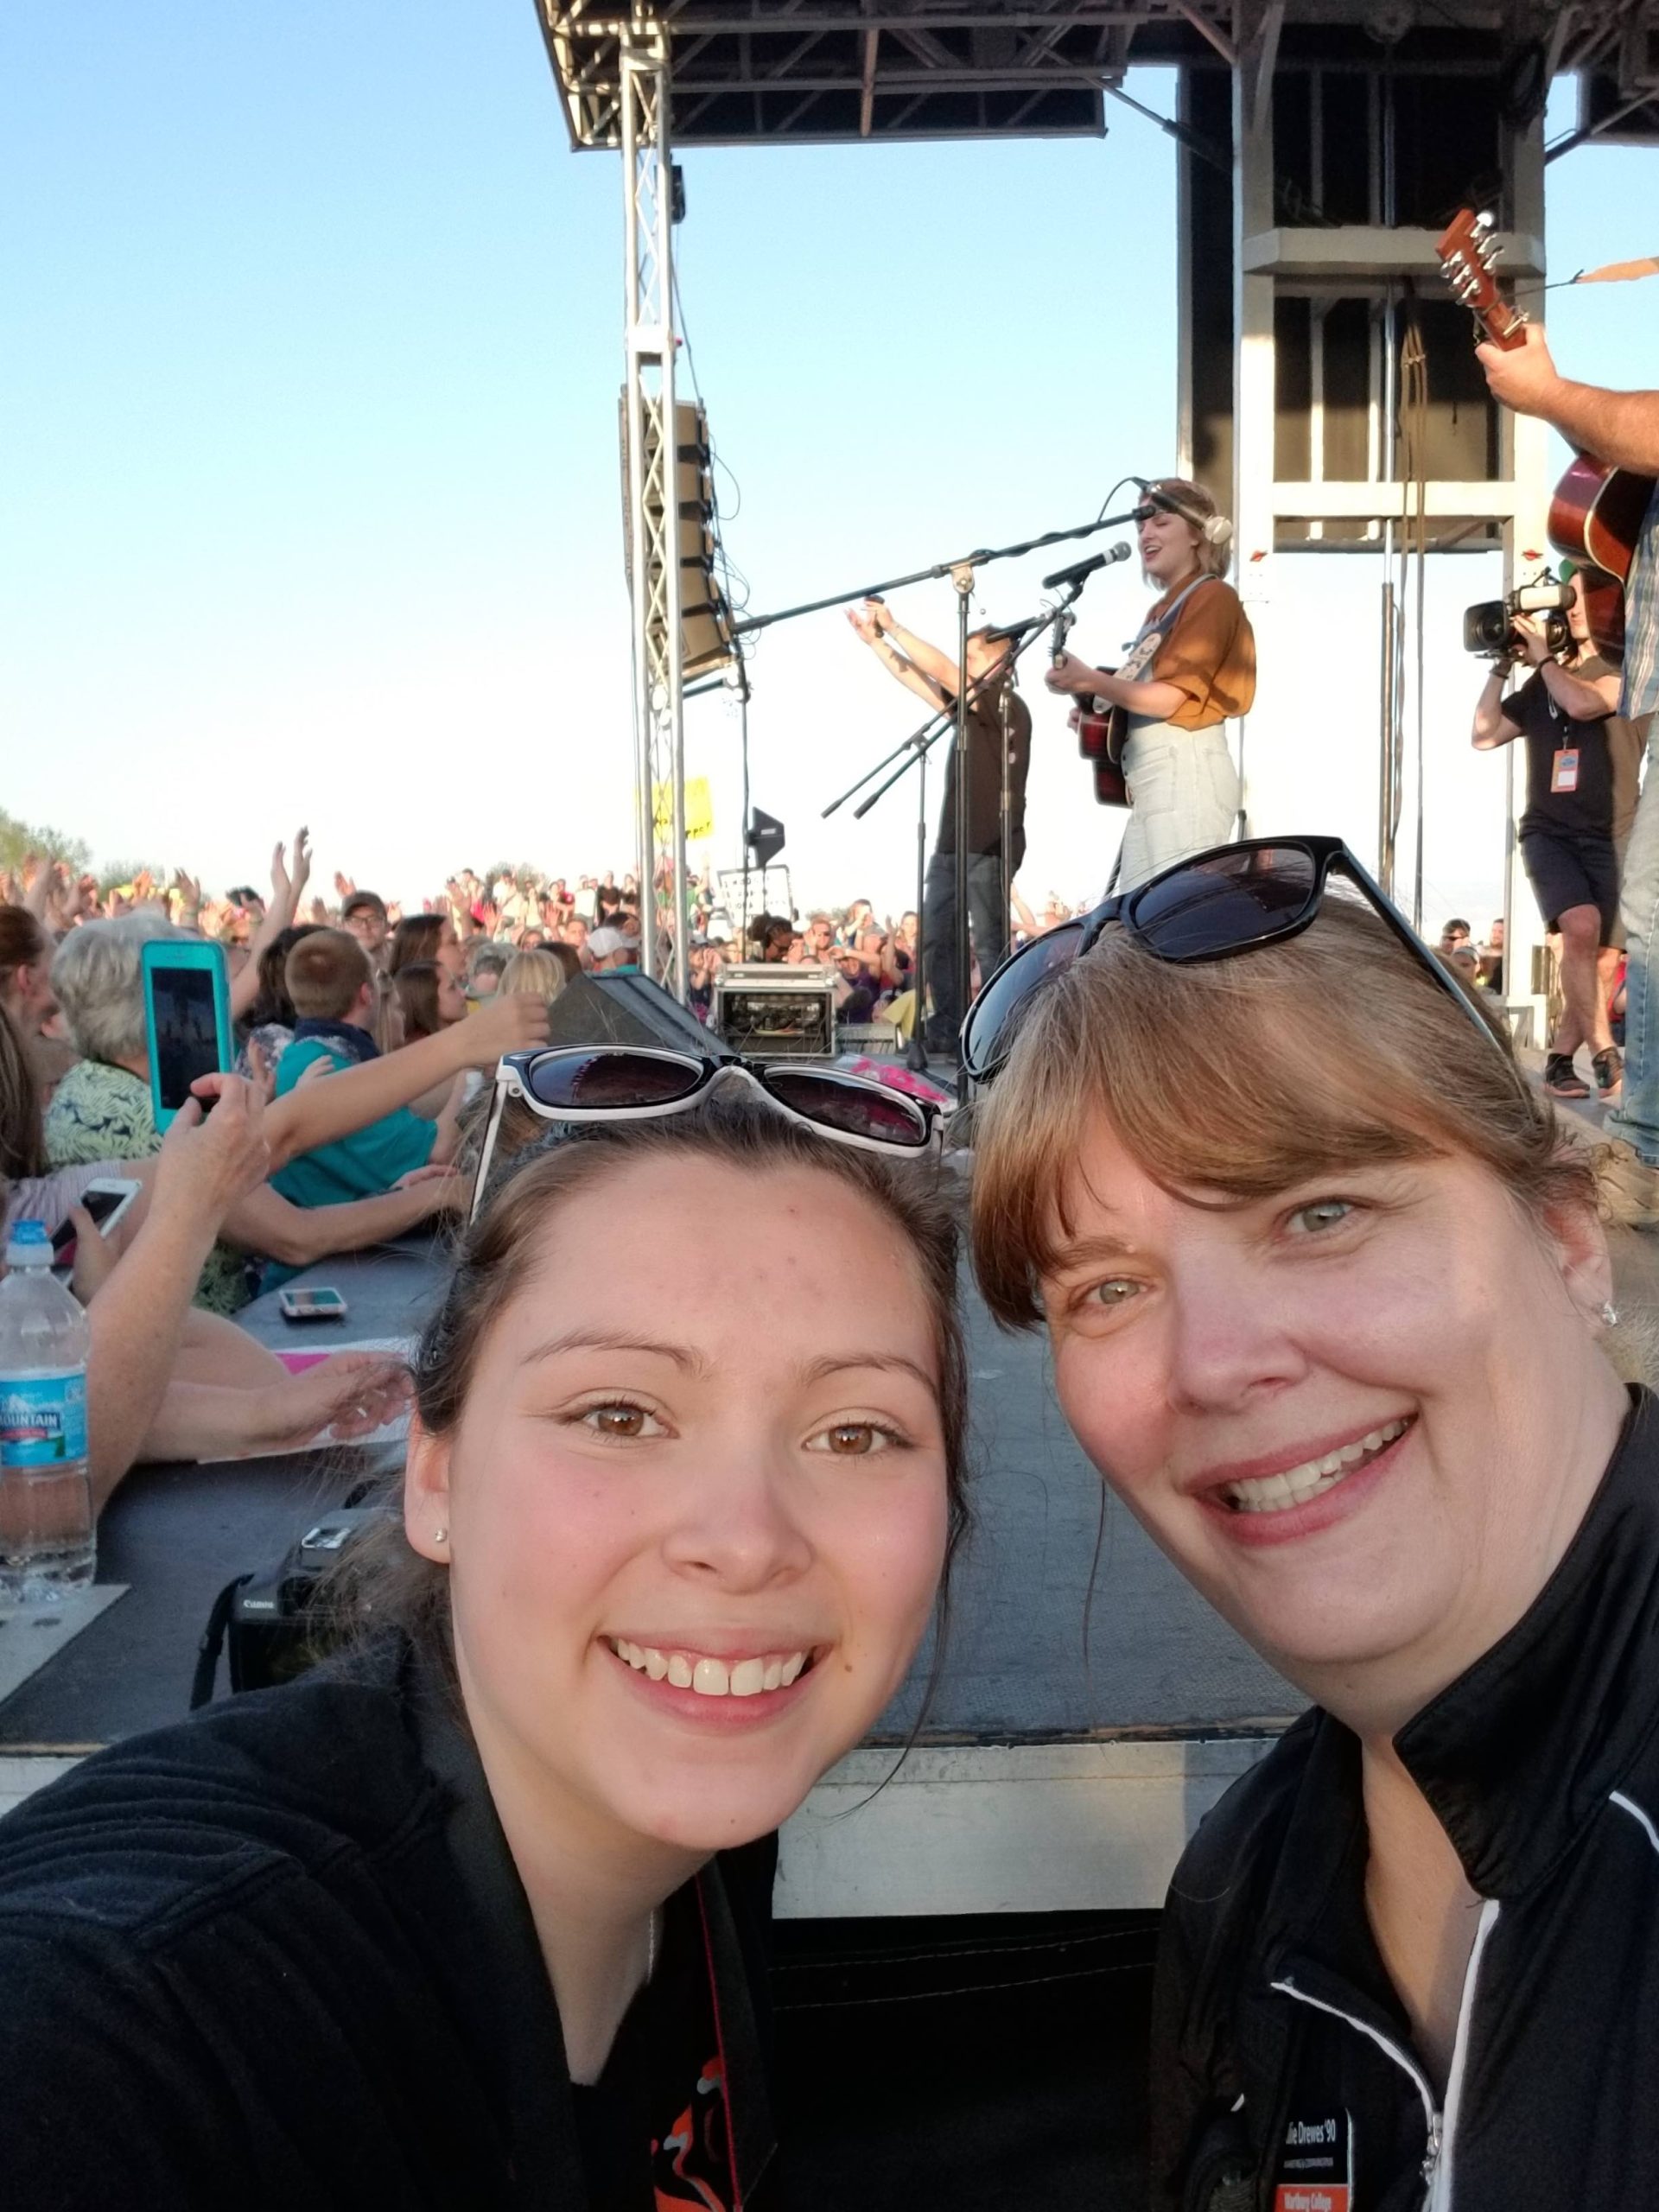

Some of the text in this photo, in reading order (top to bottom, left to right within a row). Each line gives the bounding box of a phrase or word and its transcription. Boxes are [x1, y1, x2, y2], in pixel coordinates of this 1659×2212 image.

[0, 1413, 58, 1427] OUNTAIN
[243, 1599, 274, 1609] Canon
[1298, 2120, 1325, 2145] Drewes
[1311, 2191, 1332, 2212] College
